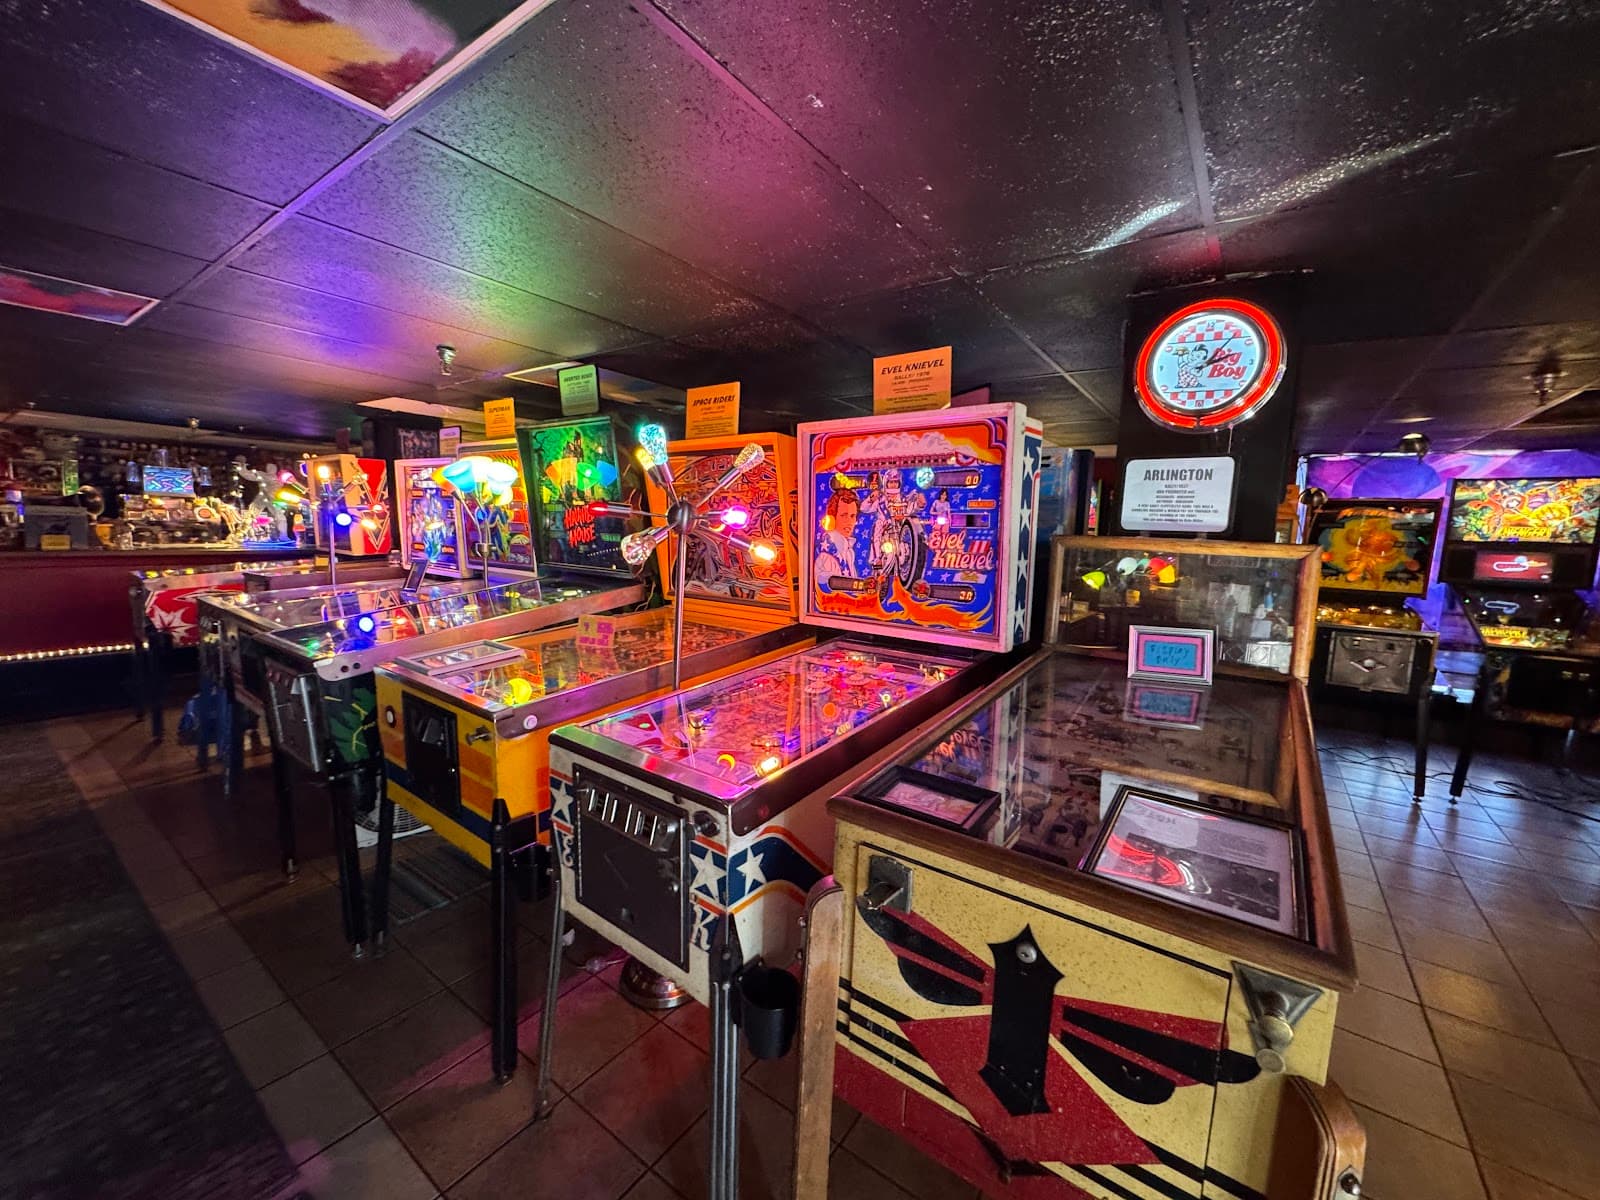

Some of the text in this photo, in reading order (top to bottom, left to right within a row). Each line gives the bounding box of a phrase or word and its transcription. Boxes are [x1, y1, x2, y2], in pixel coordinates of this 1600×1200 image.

[1212, 347, 1243, 366] Big
[881, 359, 945, 375] EVEL KNIEVEL
[1207, 364, 1248, 379] Boy
[1143, 468, 1214, 481] ARLINGTON
[568, 525, 597, 548] HOUSE
[928, 529, 967, 552] Evel
[931, 548, 995, 570] Knievel
